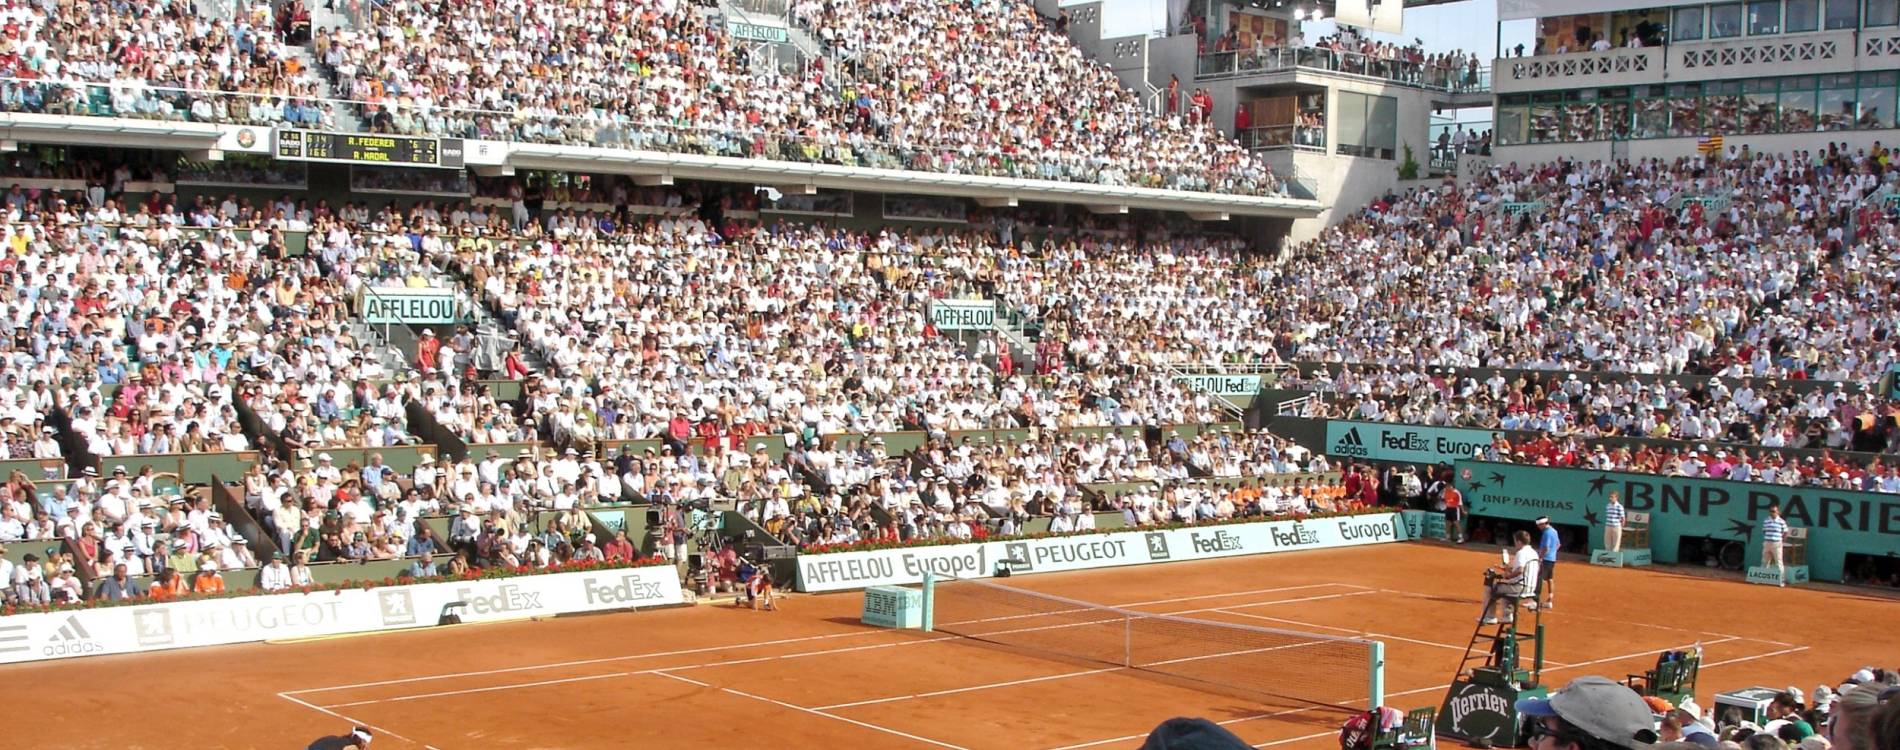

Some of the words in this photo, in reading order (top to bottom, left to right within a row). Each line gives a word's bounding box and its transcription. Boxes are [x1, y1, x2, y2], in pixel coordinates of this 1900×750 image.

[367, 299, 453, 318] AFFLELOU
[1335, 445, 1368, 456] adidas
[1381, 430, 1430, 452] FedEx
[1437, 437, 1491, 458] Europe
[1482, 494, 1512, 504] BNP
[1514, 497, 1574, 511] PARIBAS
[1624, 480, 1730, 516] BNP
[807, 557, 894, 584] AFFLELOU
[1035, 540, 1126, 564] PEUGEOT
[1191, 530, 1243, 553] FedEx
[1270, 524, 1320, 547] FedEx
[43, 640, 104, 656] adidas
[457, 584, 544, 615] FedEx
[583, 575, 664, 605] FedEx
[866, 592, 897, 617] IBM
